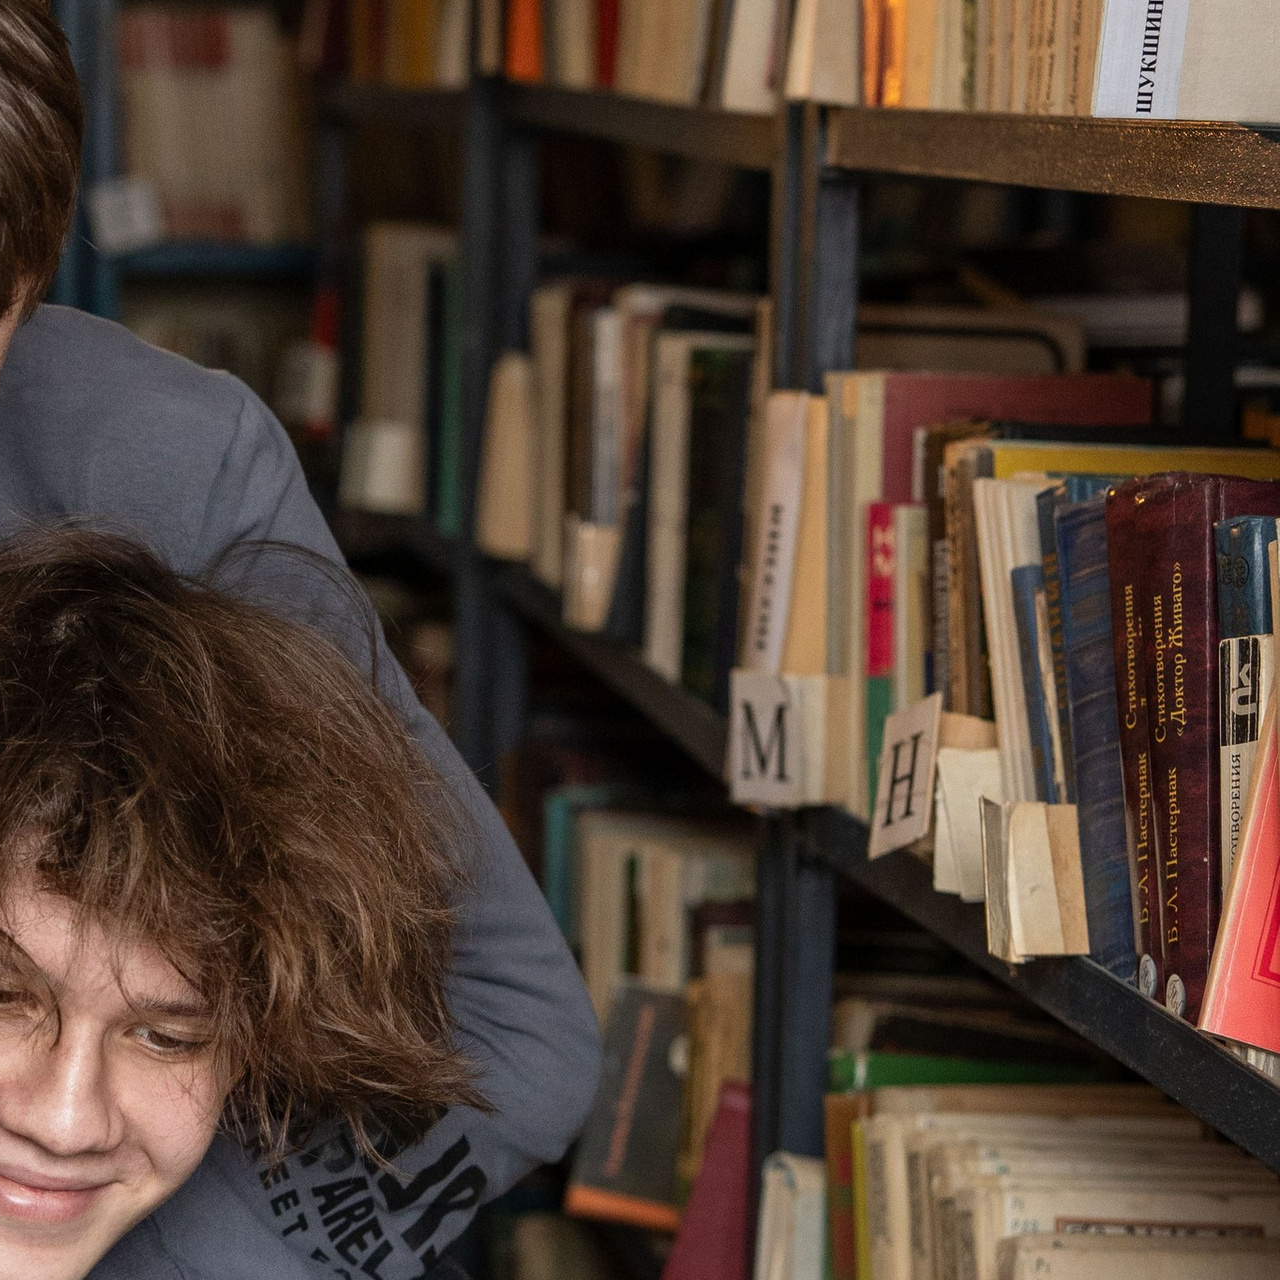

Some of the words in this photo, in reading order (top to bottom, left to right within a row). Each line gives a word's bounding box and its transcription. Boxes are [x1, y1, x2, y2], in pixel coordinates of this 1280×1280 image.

[1168, 561, 1184, 649] Живаго»
[1124, 584, 1138, 730] Стихотворения
[1153, 594, 1168, 744] Стихотворения
[1170, 652, 1187, 737] «Доктор
[741, 700, 790, 783] М
[881, 730, 925, 829] Н
[1137, 752, 1152, 862] Пастернак
[1166, 766, 1181, 880] Пастернак
[1166, 885, 1179, 912] Л.
[1167, 919, 1179, 945] Б.
